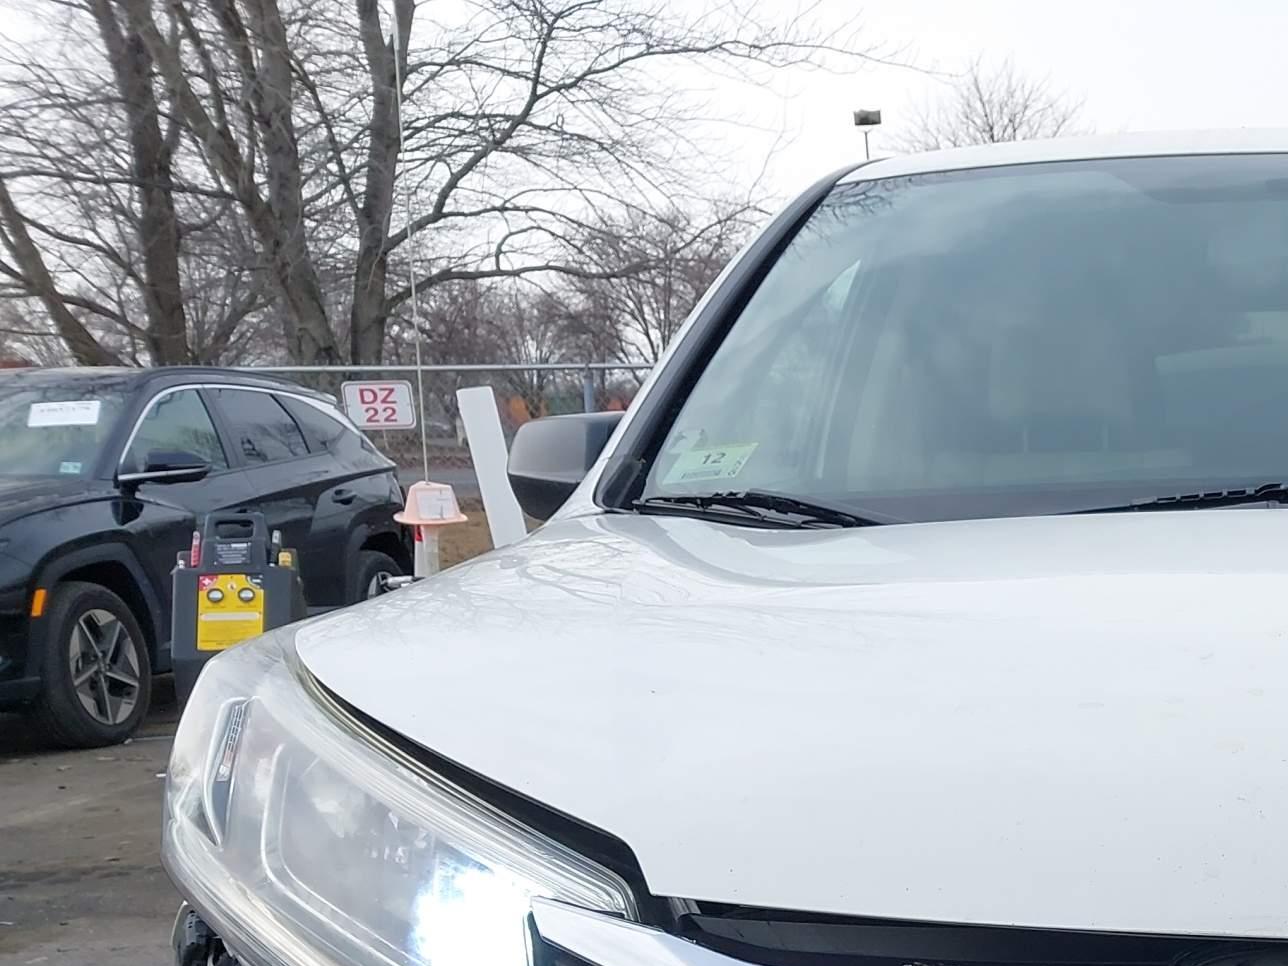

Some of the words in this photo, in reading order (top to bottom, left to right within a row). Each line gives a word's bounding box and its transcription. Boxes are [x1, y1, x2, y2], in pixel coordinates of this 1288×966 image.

[358, 387, 398, 405] DZ
[364, 406, 398, 423] 22
[701, 452, 727, 465] 12
